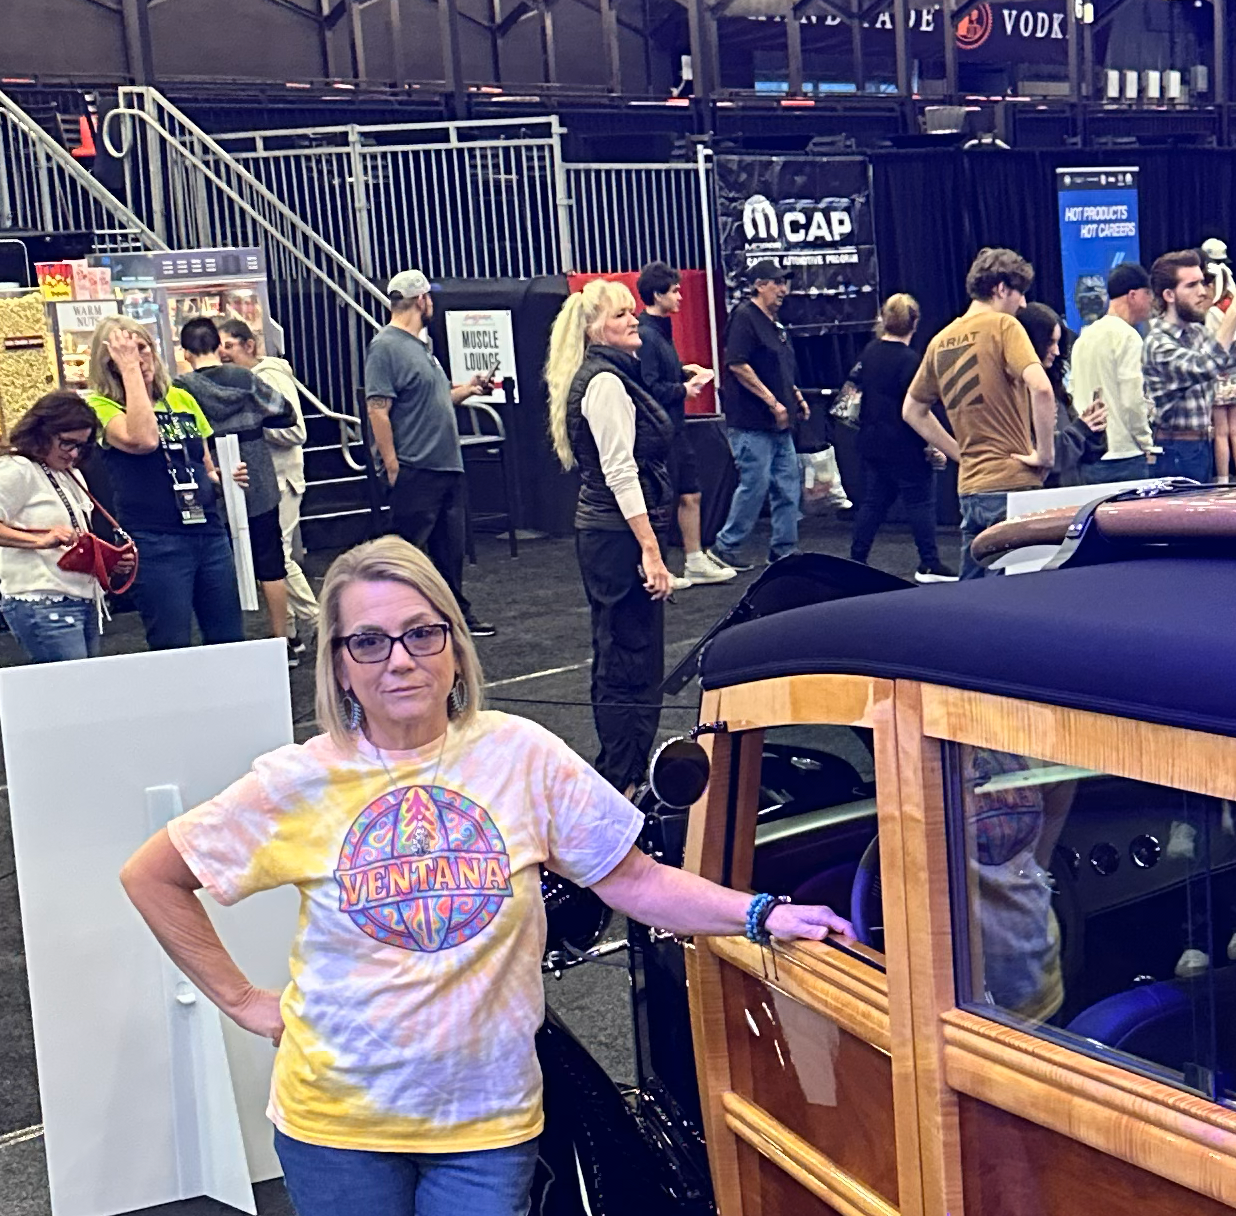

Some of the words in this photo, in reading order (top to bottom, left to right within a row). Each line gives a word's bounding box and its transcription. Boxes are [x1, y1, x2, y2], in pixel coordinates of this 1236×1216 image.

[1065, 207, 1082, 222] HOT
[1083, 205, 1128, 221] PRODUCTS
[783, 211, 852, 243] CAP
[1080, 223, 1098, 239] HOT
[1098, 222, 1136, 238] CAREERS
[72, 305, 103, 317] WARM
[461, 330, 499, 350] MUSCLE
[938, 331, 979, 349] ARIAT
[339, 857, 508, 907] VENTANA
